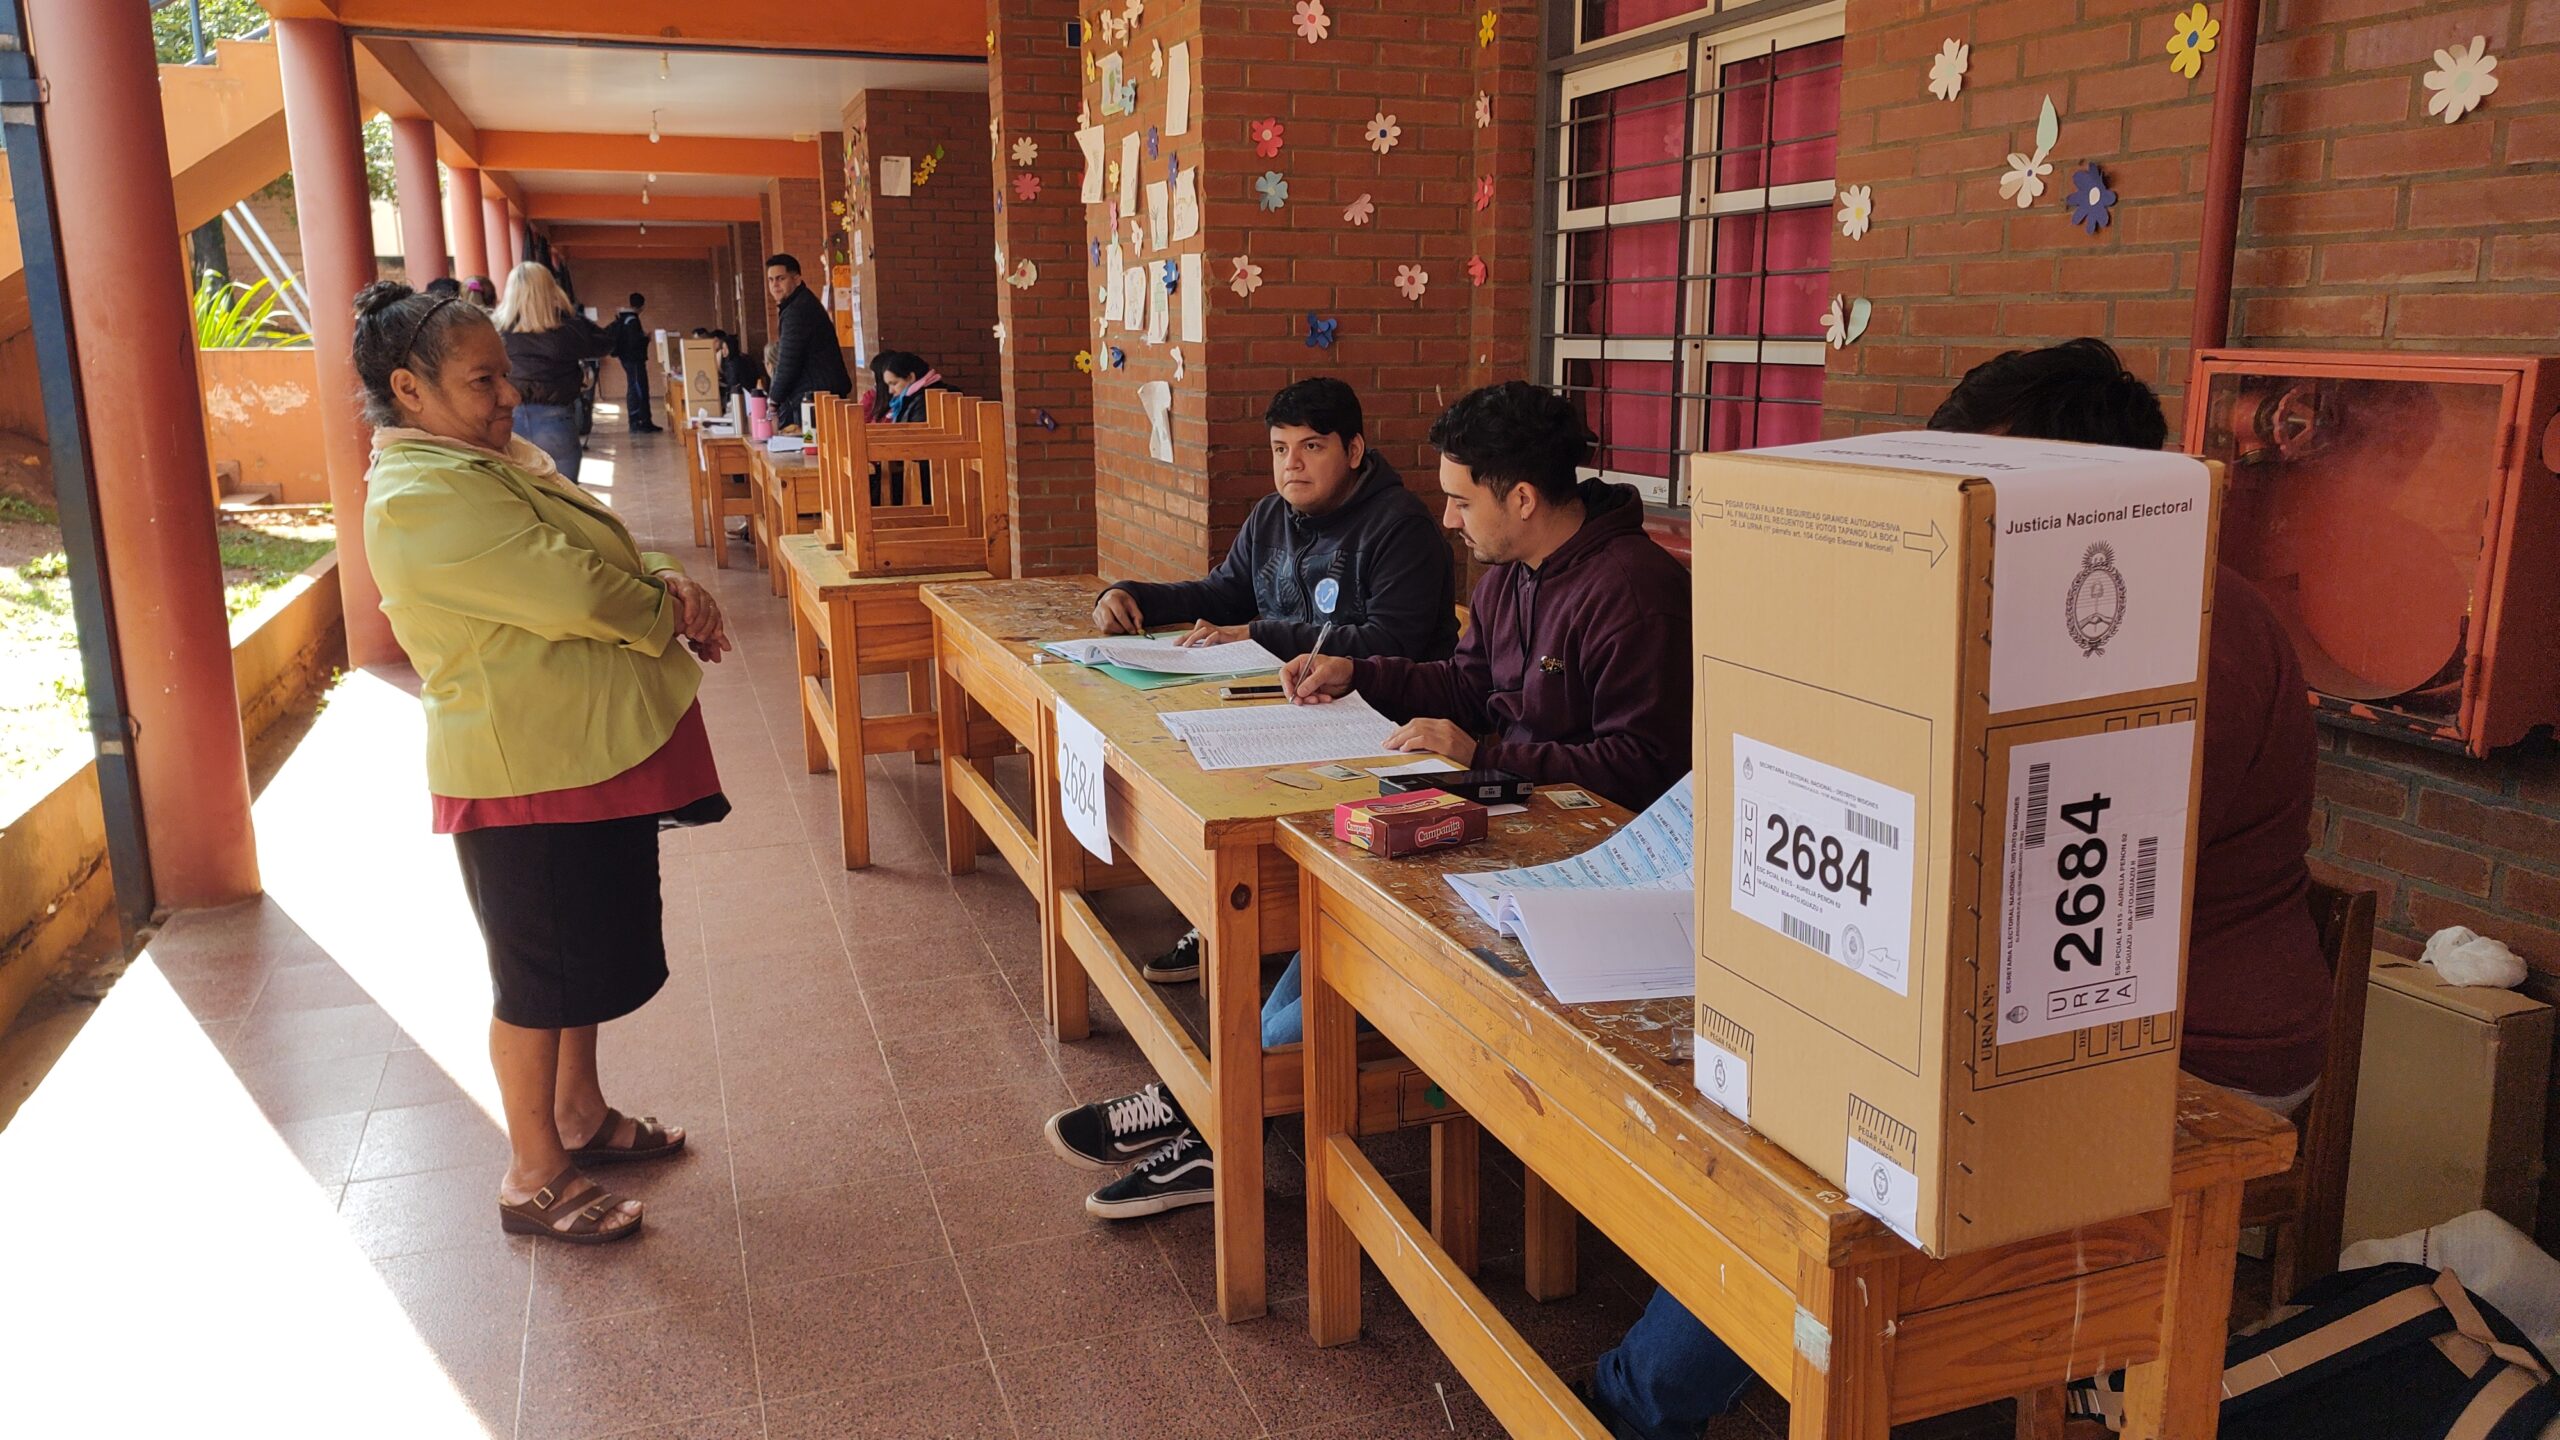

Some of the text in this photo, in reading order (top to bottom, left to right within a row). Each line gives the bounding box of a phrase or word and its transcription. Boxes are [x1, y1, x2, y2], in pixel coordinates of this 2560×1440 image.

[1734, 510, 1763, 521] FINALIZAR
[1763, 514, 1770, 523] EL
[1772, 516, 1804, 528] RECUENTO
[1805, 521, 1813, 529] DE
[1815, 522, 1837, 533] VOTOS
[1838, 526, 1868, 538] TAPANDO
[1869, 531, 1877, 539] LA
[1879, 532, 1898, 542] BOCA
[1744, 502, 1760, 511] OTRA
[1761, 504, 1775, 513] FAJA
[1776, 506, 1784, 514] DE
[1786, 508, 1820, 520] SEGURIDAD
[1822, 512, 1849, 525] GRANDE
[1850, 517, 1900, 531] AUTOADHESIVA
[2005, 498, 2193, 535] Justicia Nacional Electoral
[1837, 536, 1863, 548] Electoral
[1063, 742, 1097, 827] 2684
[1417, 820, 1461, 843] Campanita
[1742, 803, 1754, 889] URNA
[1766, 813, 1872, 907] 2684
[2119, 843, 2127, 871] PENON
[2053, 792, 2111, 972] 2684
[2117, 873, 2125, 906] AURELIA
[2005, 950, 2013, 994] SECRETARIA
[2051, 983, 2132, 1013] URNA
[1980, 1012, 1995, 1061] URNA
[1858, 1125, 1894, 1152] PEGAR FAJA
